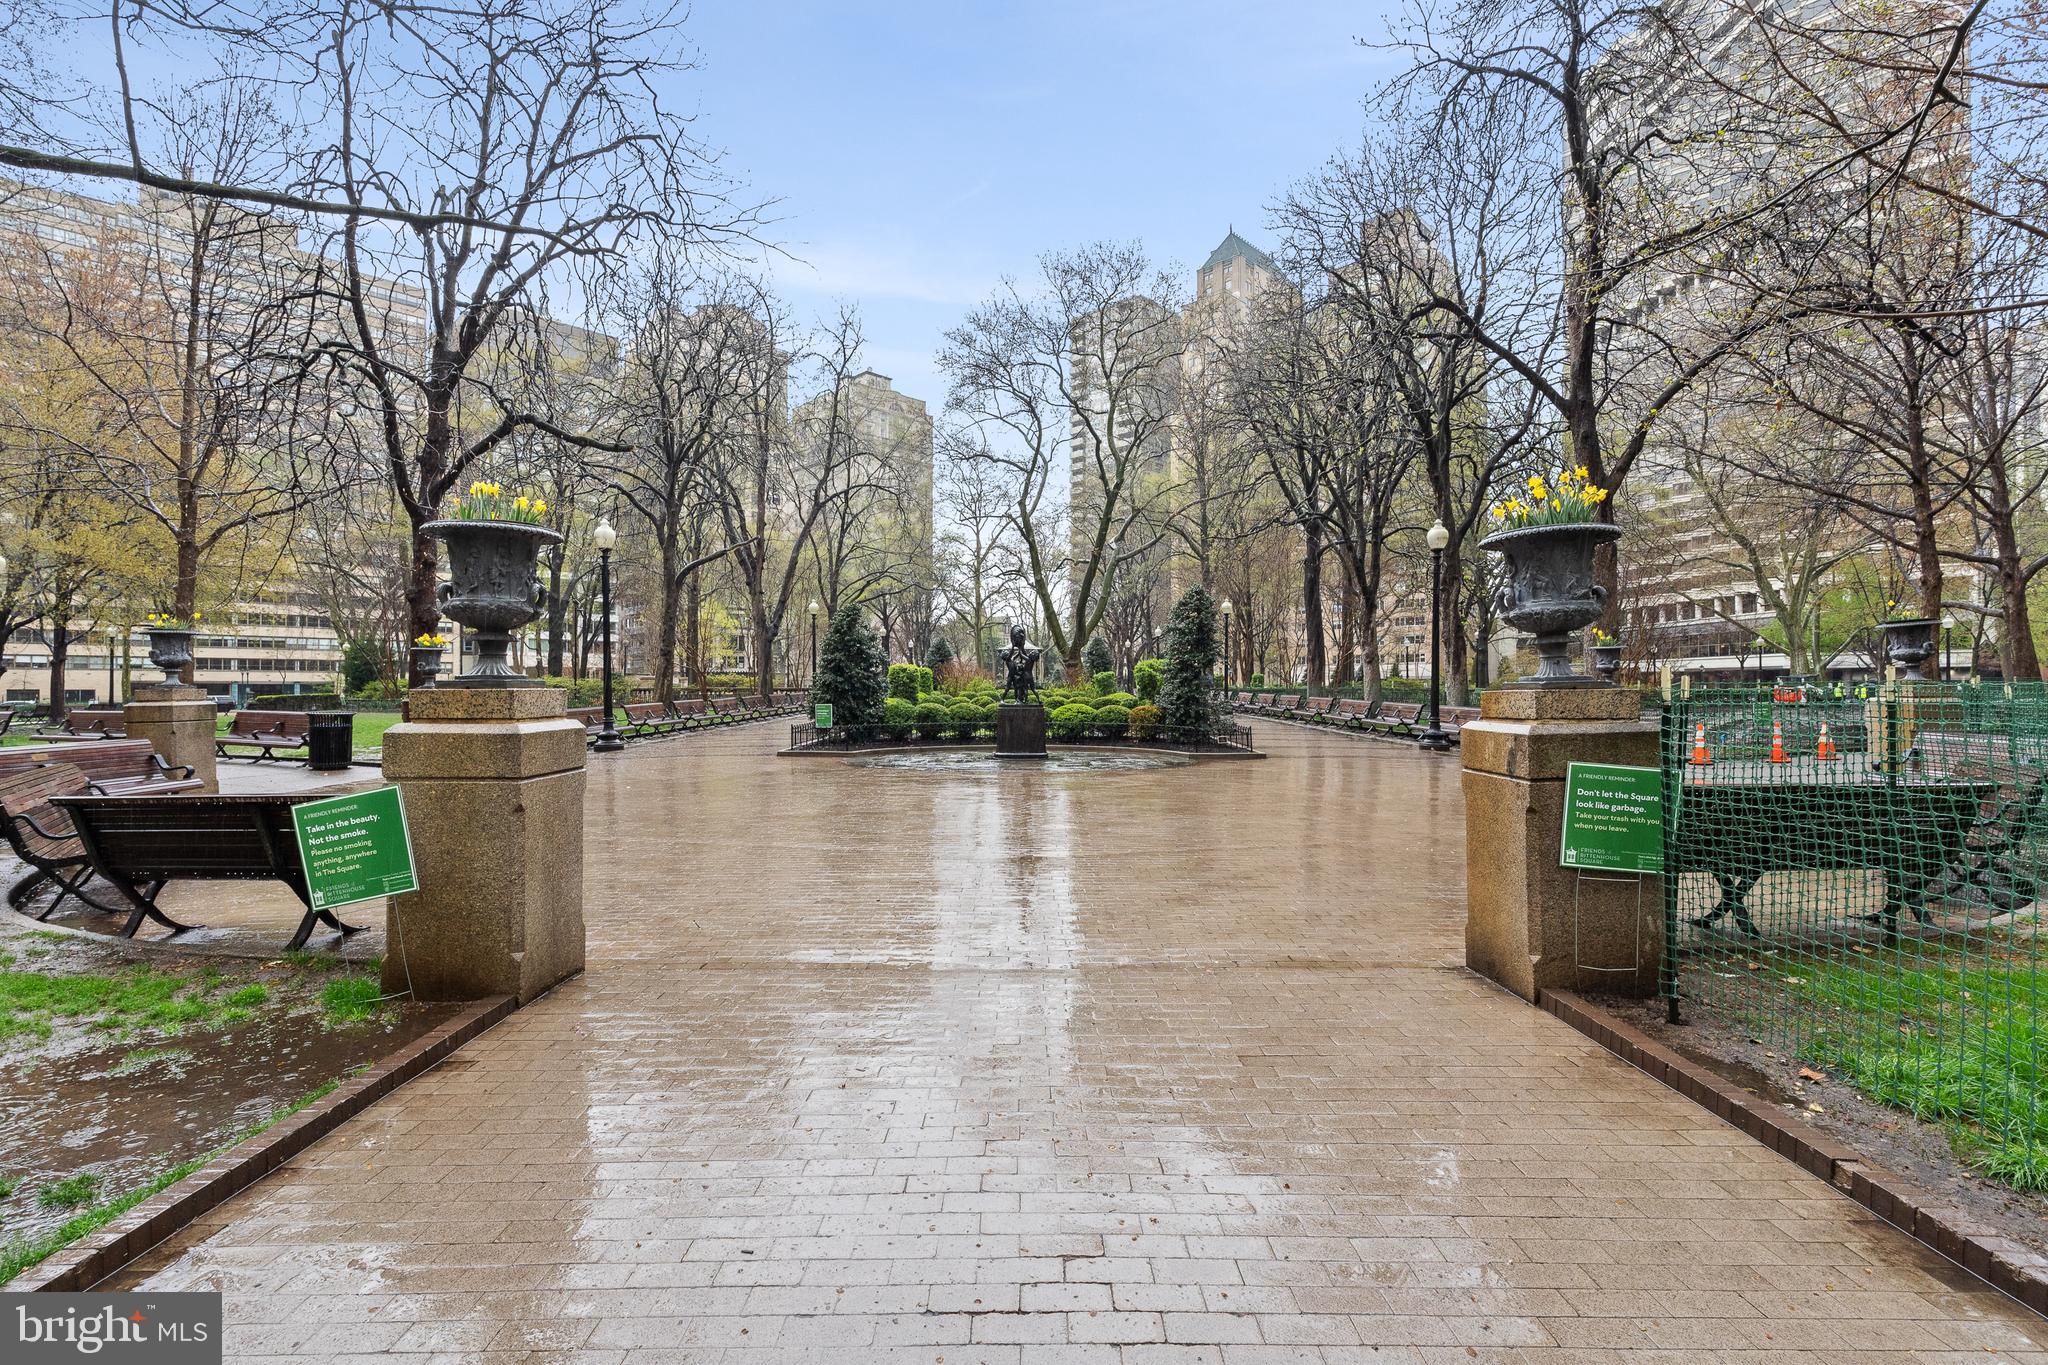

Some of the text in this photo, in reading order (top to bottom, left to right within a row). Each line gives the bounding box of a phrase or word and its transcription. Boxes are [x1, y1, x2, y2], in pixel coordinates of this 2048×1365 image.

[1577, 788, 1659, 802] Don't let the Square
[1576, 800, 1647, 814] look like garbage.
[307, 810, 331, 819] FRIENDLY
[1575, 811, 1592, 819] Take
[1610, 814, 1629, 822] trash
[1630, 816, 1646, 824] with
[306, 814, 380, 833] Take in the beauty.
[1608, 825, 1629, 833] leave.
[308, 829, 369, 846] Not the smoke.
[311, 847, 332, 857] Please
[344, 839, 372, 850] smoking
[1580, 847, 1605, 855] FRIENDS
[313, 849, 377, 868] anything, anywhere
[1580, 852, 1620, 861] RITTENHOUSE
[323, 867, 336, 875] The
[337, 864, 362, 875] Square.
